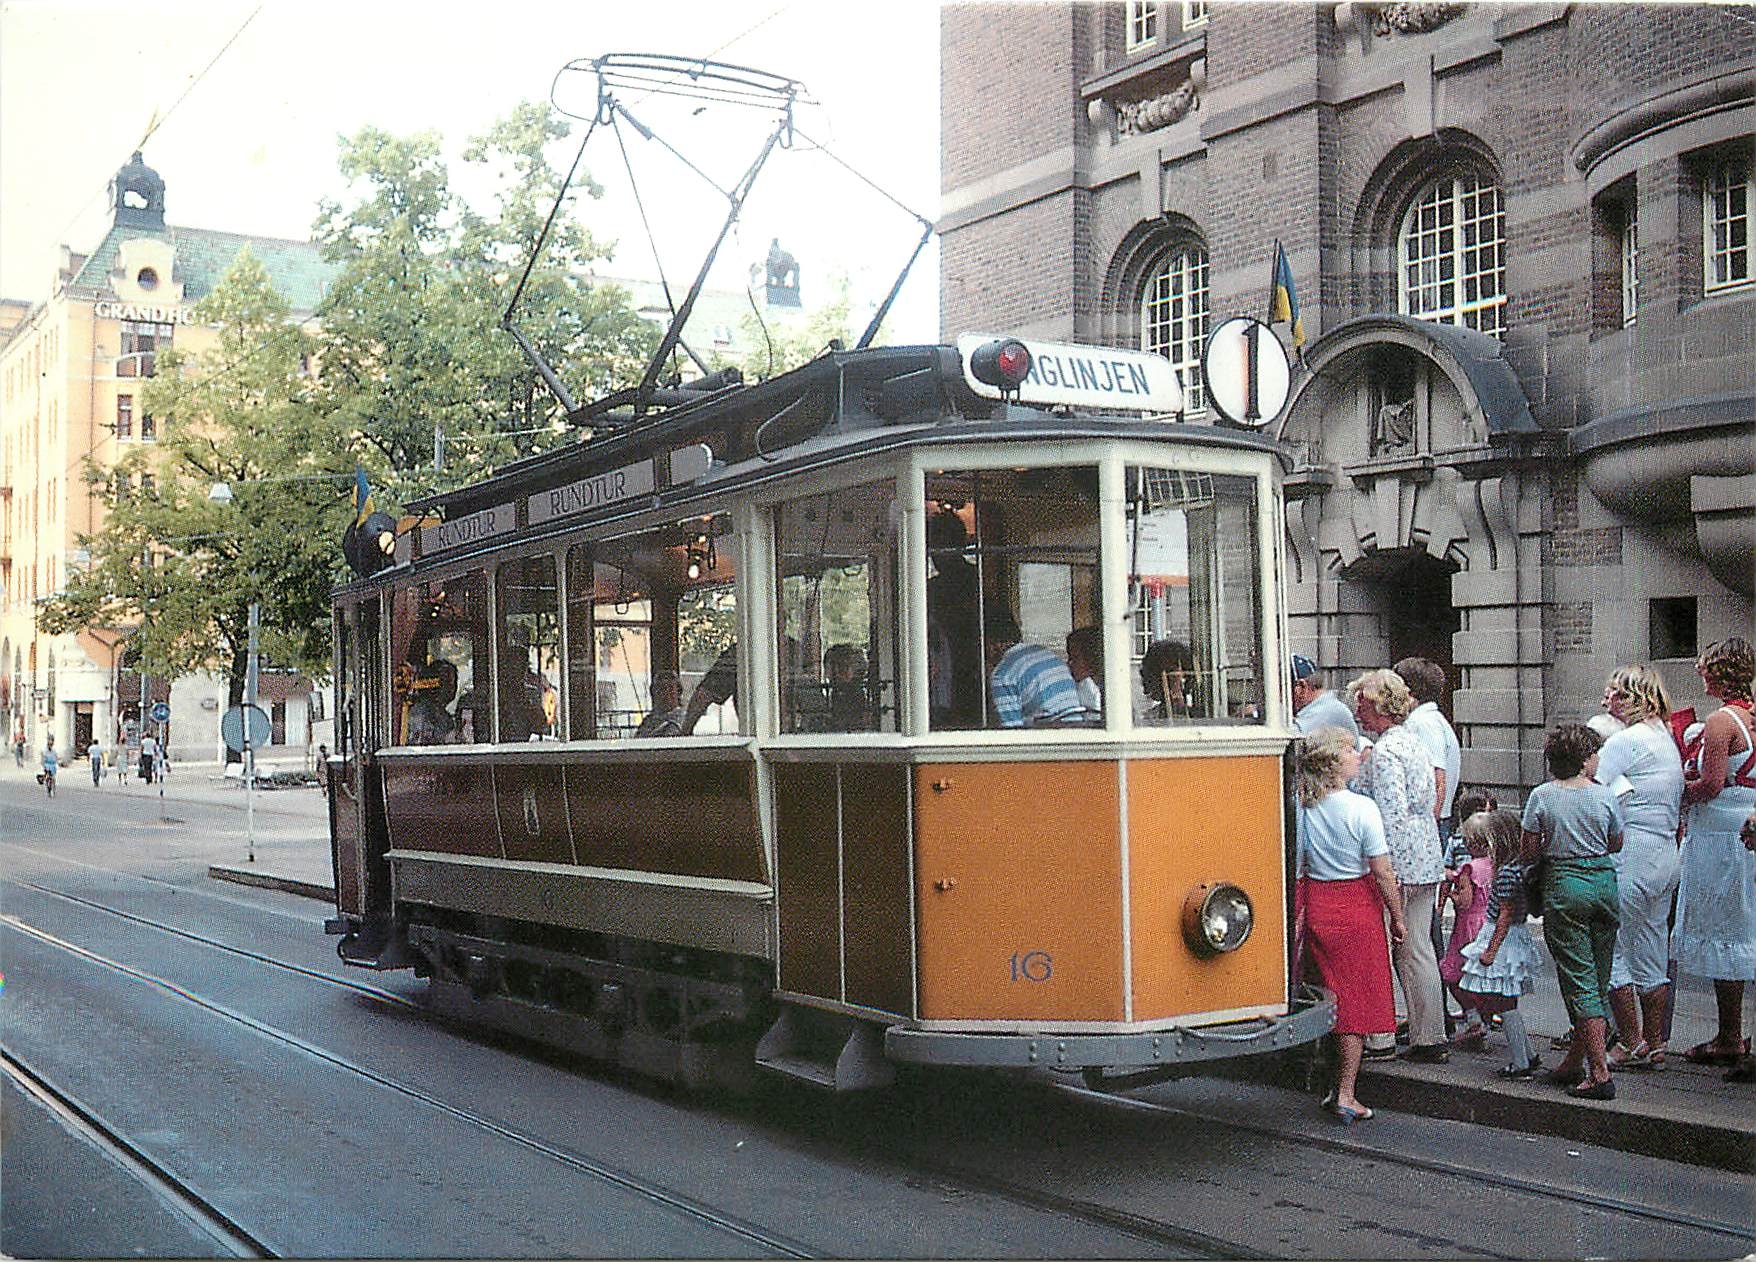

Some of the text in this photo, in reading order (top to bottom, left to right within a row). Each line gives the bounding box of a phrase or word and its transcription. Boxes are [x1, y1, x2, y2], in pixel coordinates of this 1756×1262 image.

[1026, 354, 1151, 395] NGLINJEN
[1241, 320, 1263, 419] 1
[550, 471, 626, 516] RUNDTUR
[438, 510, 495, 547] RUNDTUR
[1009, 950, 1053, 983] 16
